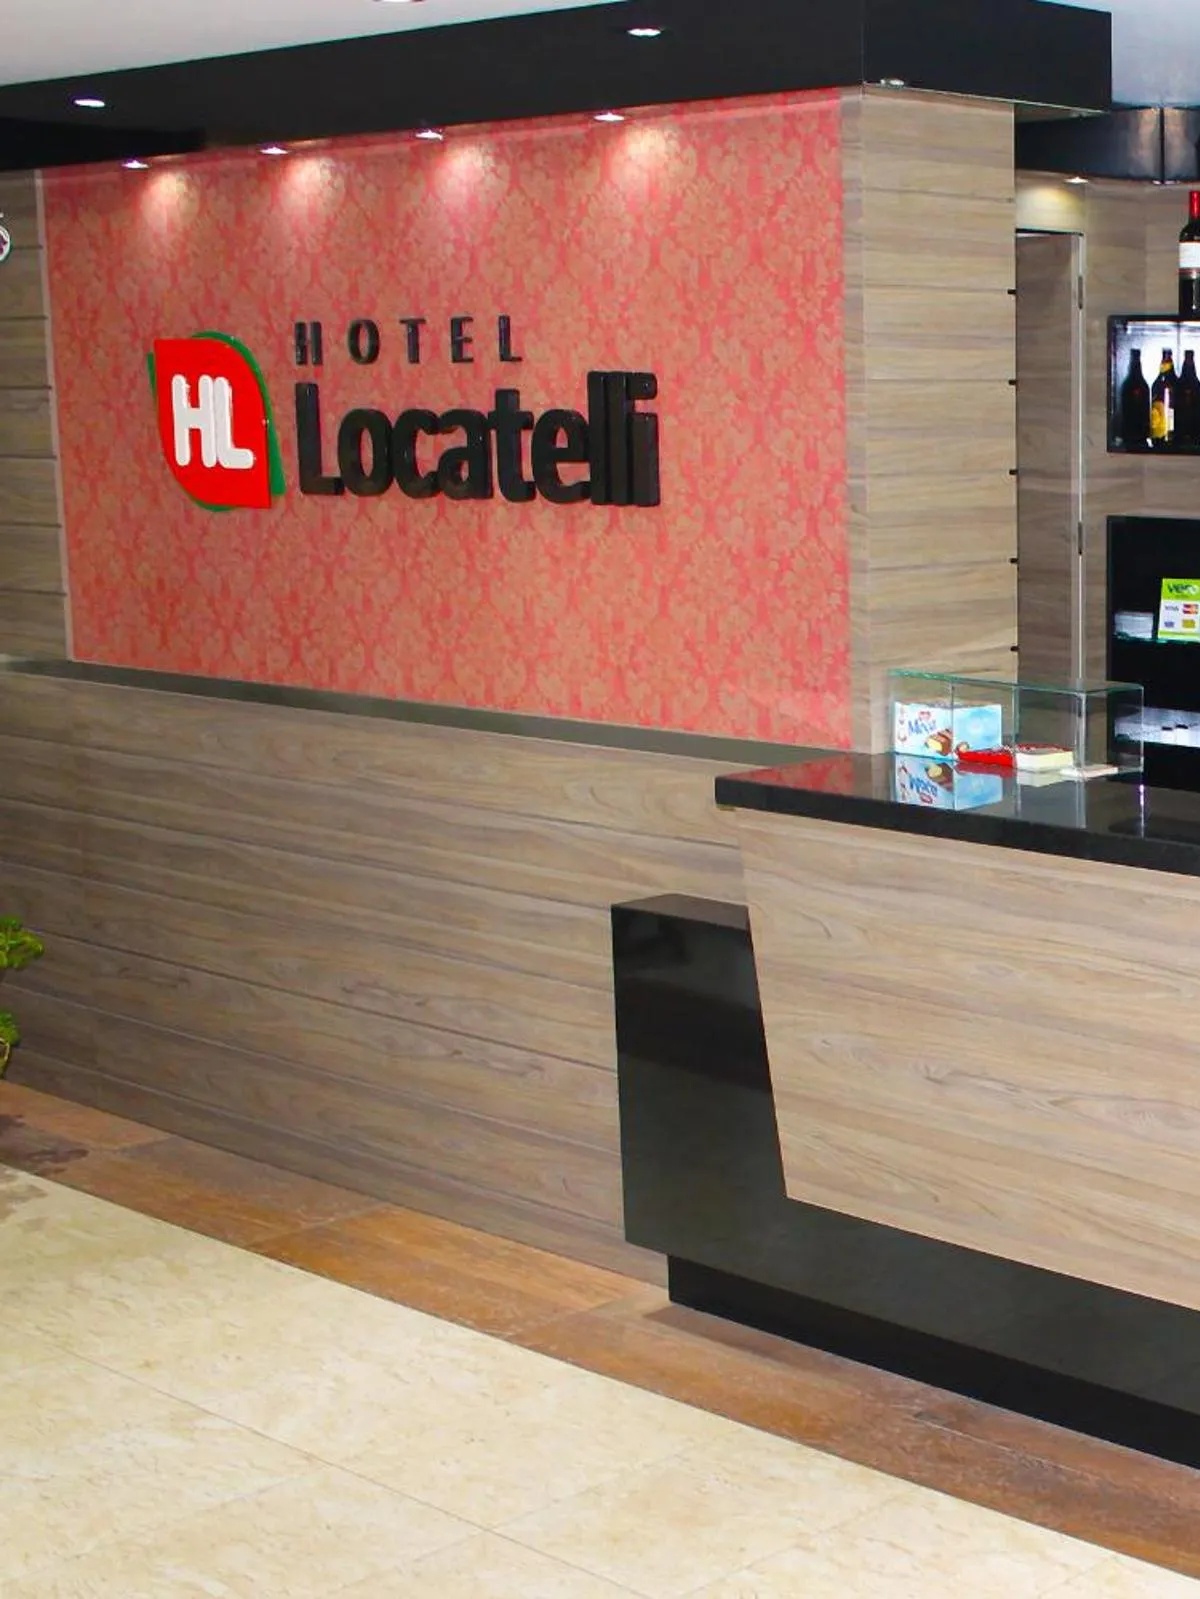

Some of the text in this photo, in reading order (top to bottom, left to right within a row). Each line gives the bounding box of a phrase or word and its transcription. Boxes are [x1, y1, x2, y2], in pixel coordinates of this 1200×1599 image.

[294, 316, 523, 365] HOTEL
[172, 374, 254, 469] HL
[295, 371, 661, 507] Locatelli
